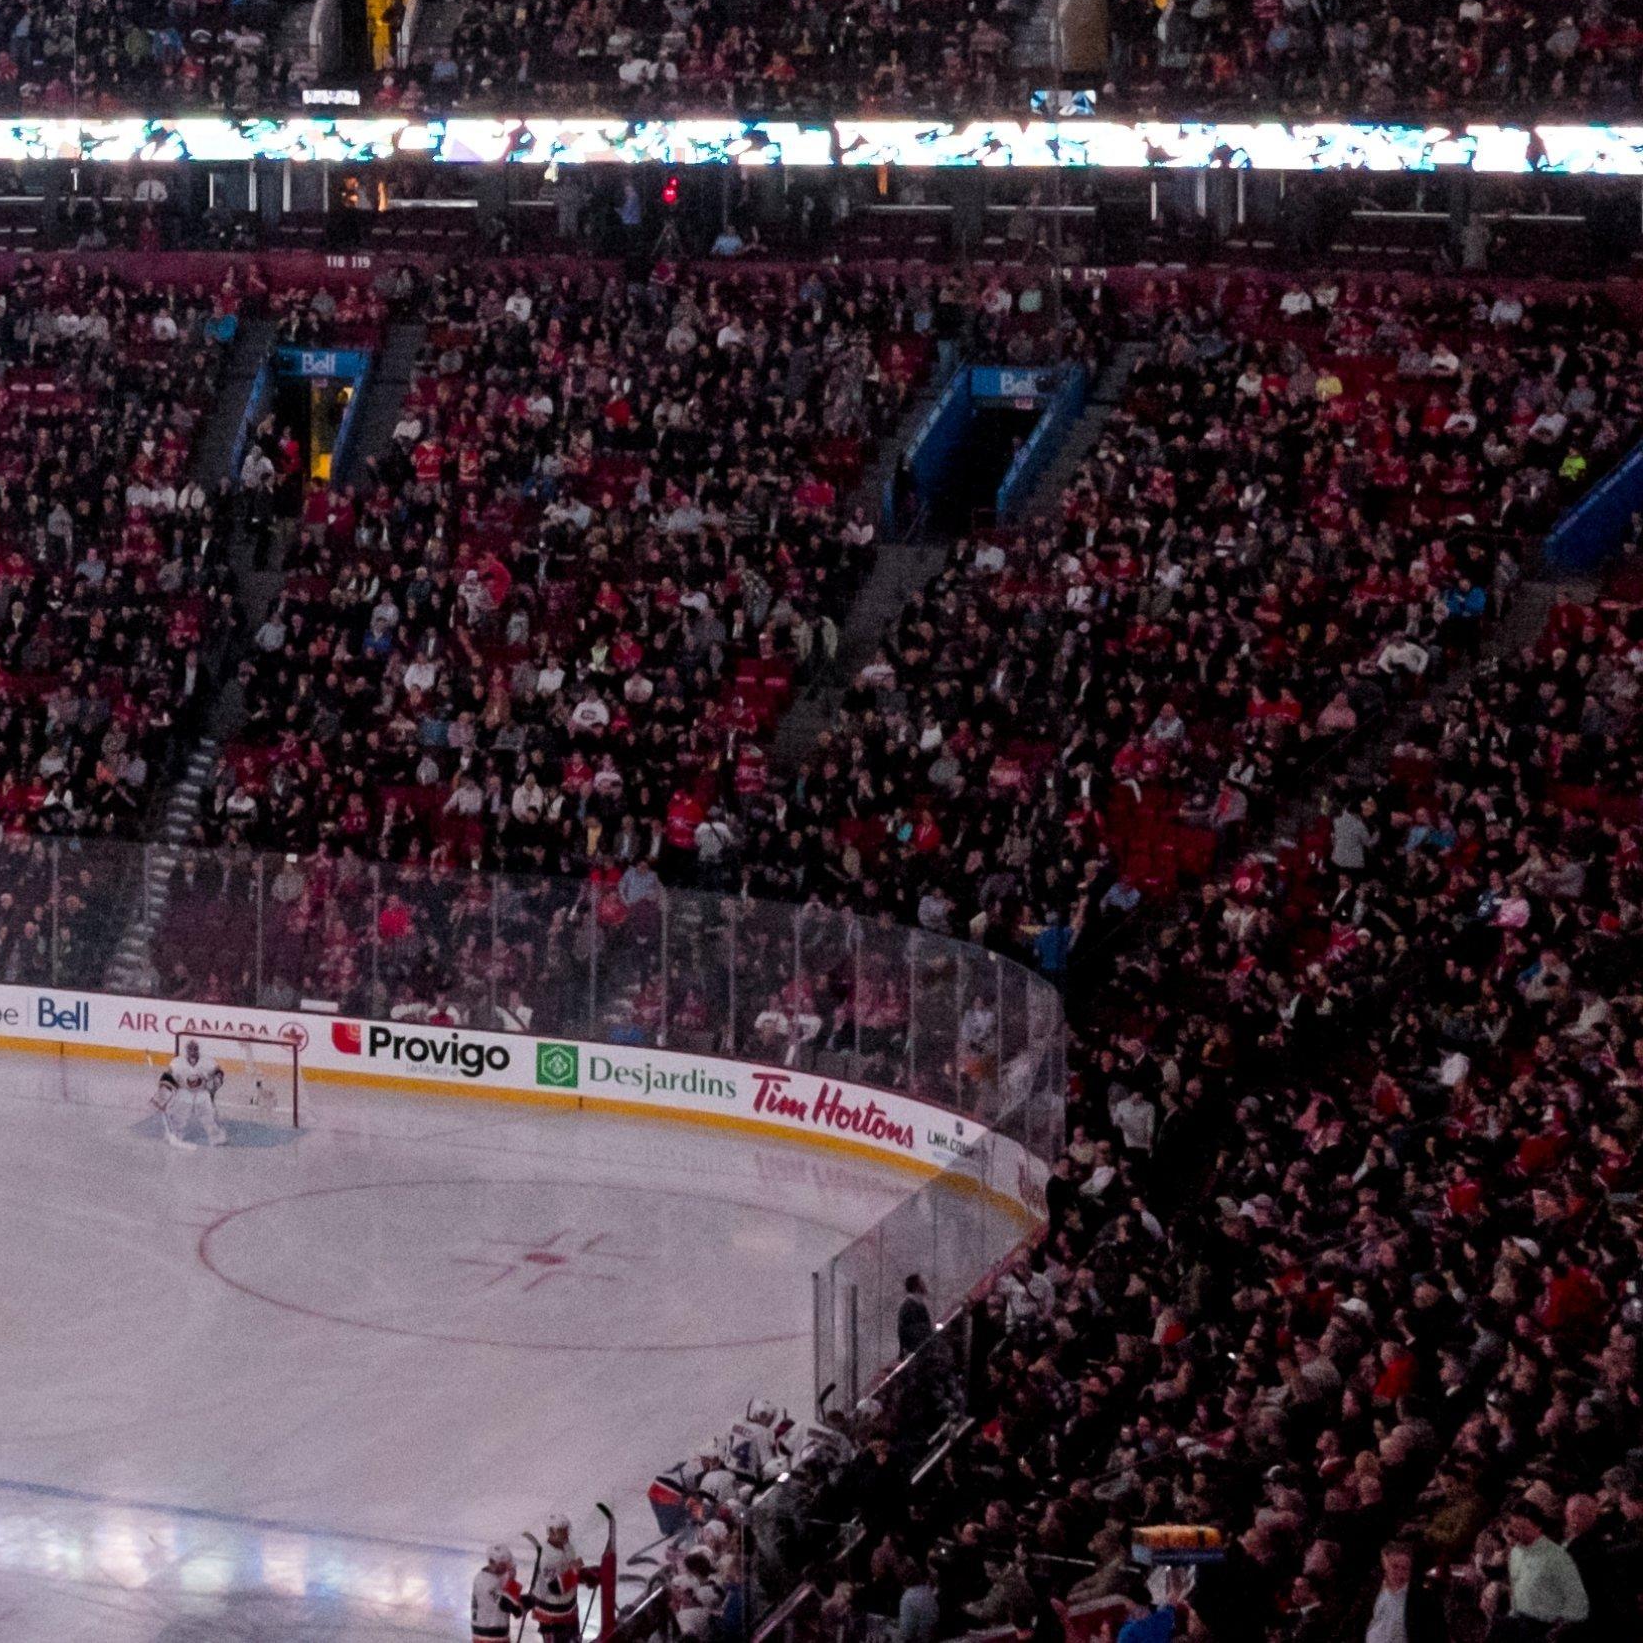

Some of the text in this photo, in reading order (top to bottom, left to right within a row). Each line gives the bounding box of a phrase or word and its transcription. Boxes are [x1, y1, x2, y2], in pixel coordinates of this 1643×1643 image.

[301, 351, 335, 375] Bell
[37, 996, 90, 1031] Bell
[117, 1010, 160, 1032] AIR
[368, 1027, 510, 1078] Provigo
[589, 1055, 737, 1100] Desjardins
[752, 1072, 915, 1150] Tim Hortons
